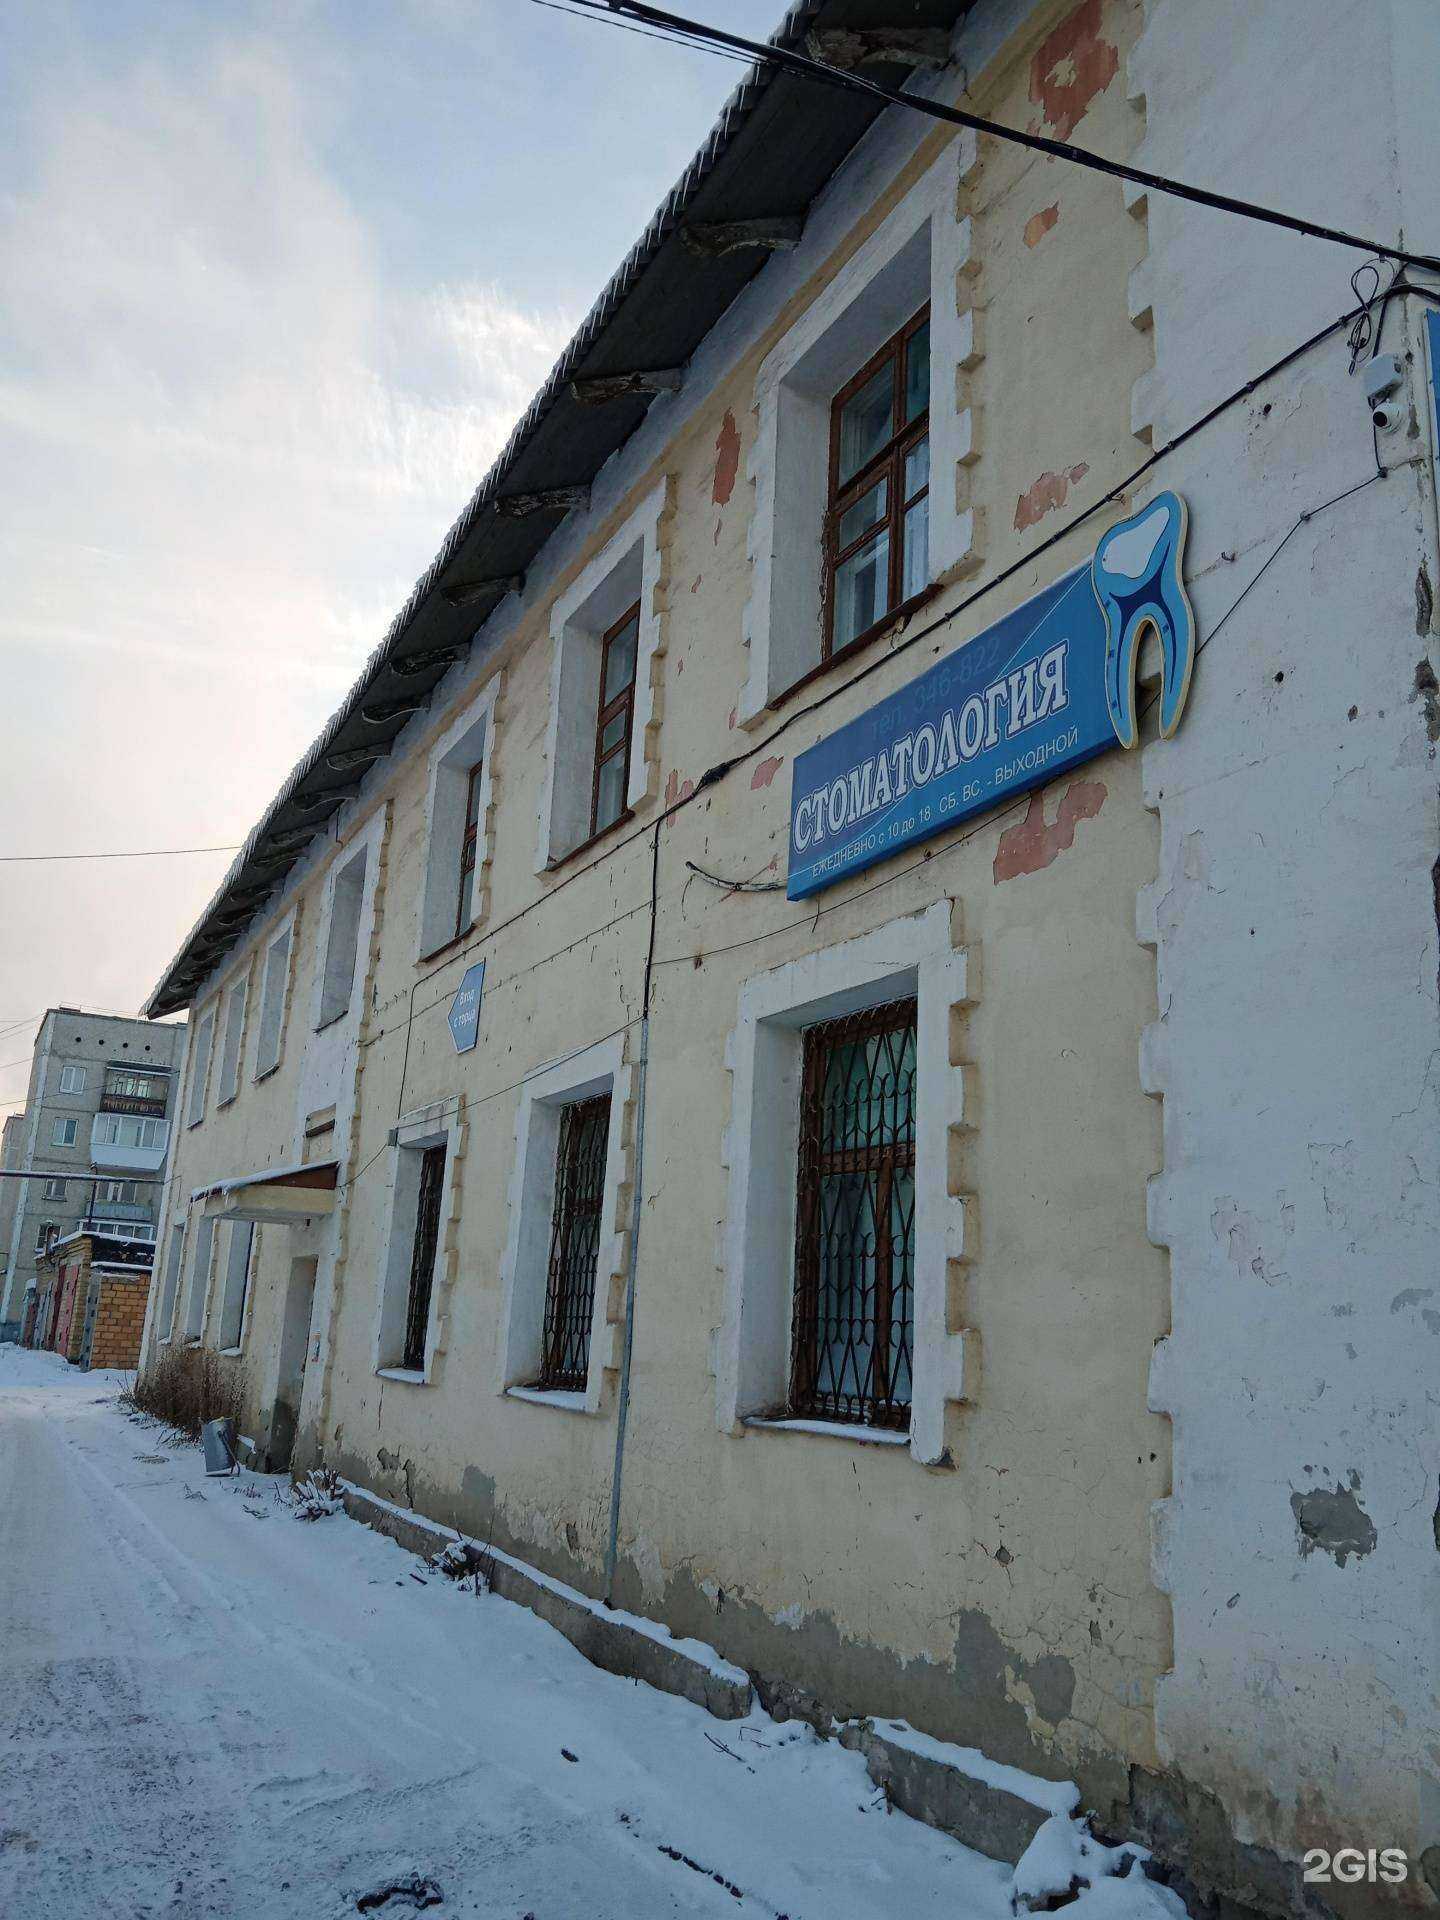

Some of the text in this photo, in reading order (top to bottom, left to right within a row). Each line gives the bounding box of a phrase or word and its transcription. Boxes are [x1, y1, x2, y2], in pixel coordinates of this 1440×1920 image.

[794, 639, 1070, 853] СТОМАТОЛОГИЯ
[812, 834, 877, 878] ЕЖЕДНЕВНО
[889, 824, 900, 839] 10
[901, 817, 915, 836] до
[919, 806, 931, 823] 18
[939, 791, 959, 813] СБ.
[963, 780, 983, 802] ВС.
[995, 724, 1079, 785] ВЫХОДНОЙ
